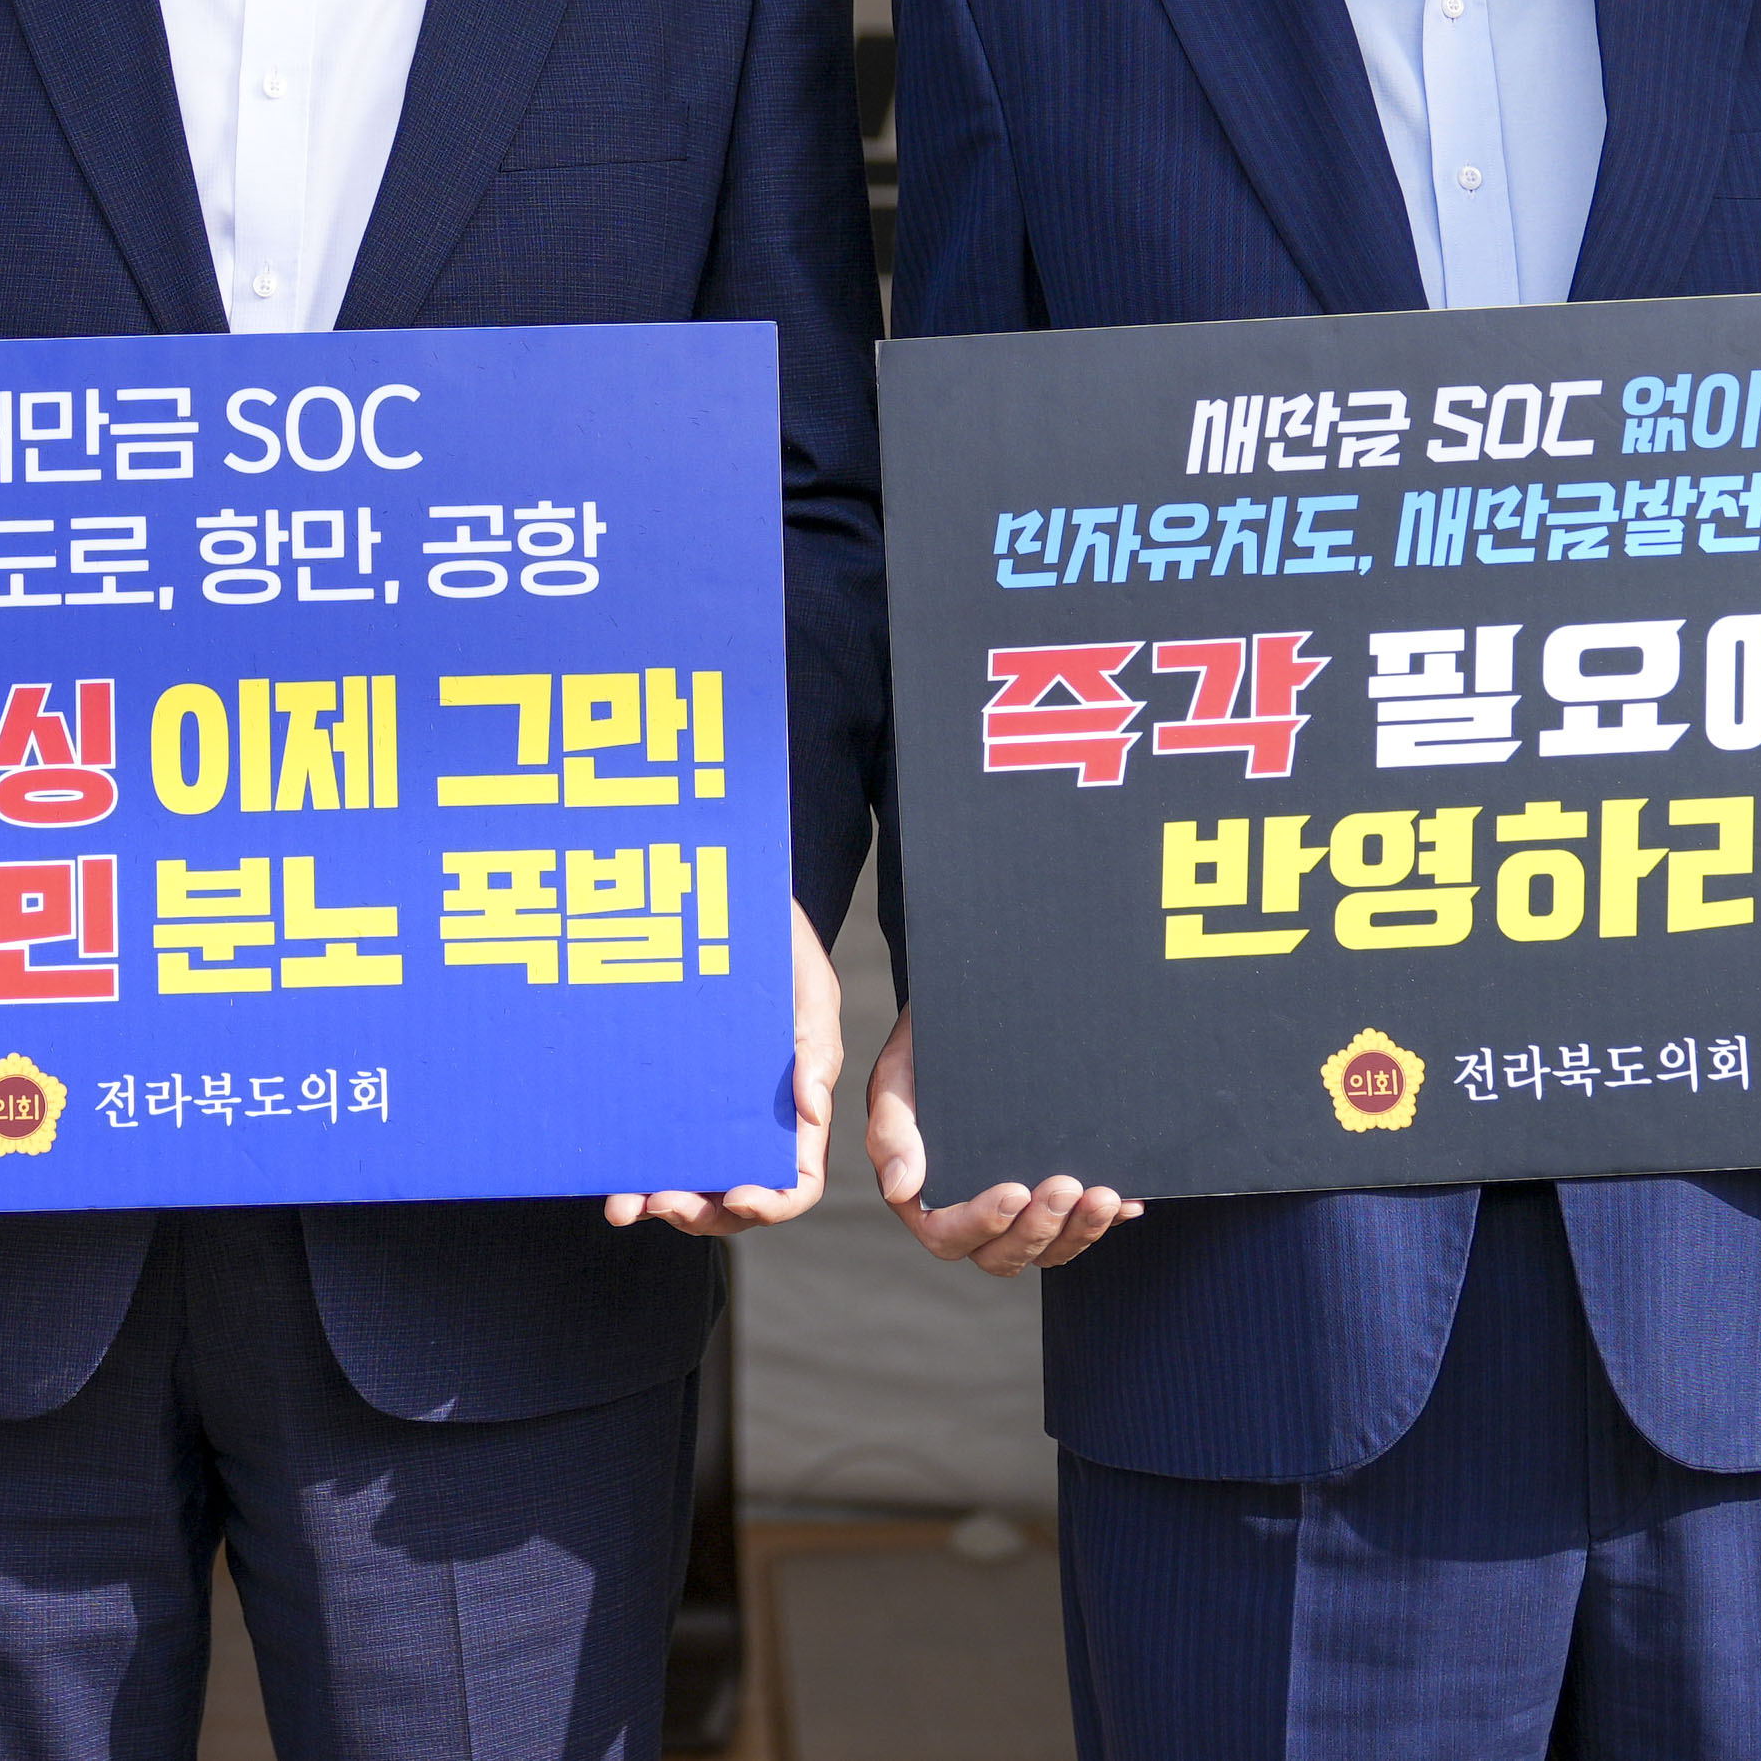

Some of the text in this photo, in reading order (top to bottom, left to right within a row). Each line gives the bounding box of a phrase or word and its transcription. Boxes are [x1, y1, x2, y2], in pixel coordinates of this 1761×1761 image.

[224, 383, 424, 474] SOC
[1185, 388, 1412, 475] 새만금
[1426, 379, 1603, 462] SOC
[195, 507, 400, 605] 항만,
[420, 499, 608, 598] 공항
[992, 494, 1375, 590] 민자유치도,
[150, 673, 399, 816] 이제
[436, 667, 727, 809] 그만!
[981, 630, 1333, 788] 즉각
[153, 854, 403, 995] 분노
[439, 842, 730, 987] 폭발!
[94, 1067, 389, 1129] 전라북도의회
[1347, 1069, 1399, 1097] 의회
[1453, 1035, 1751, 1101] 전라북도의회
